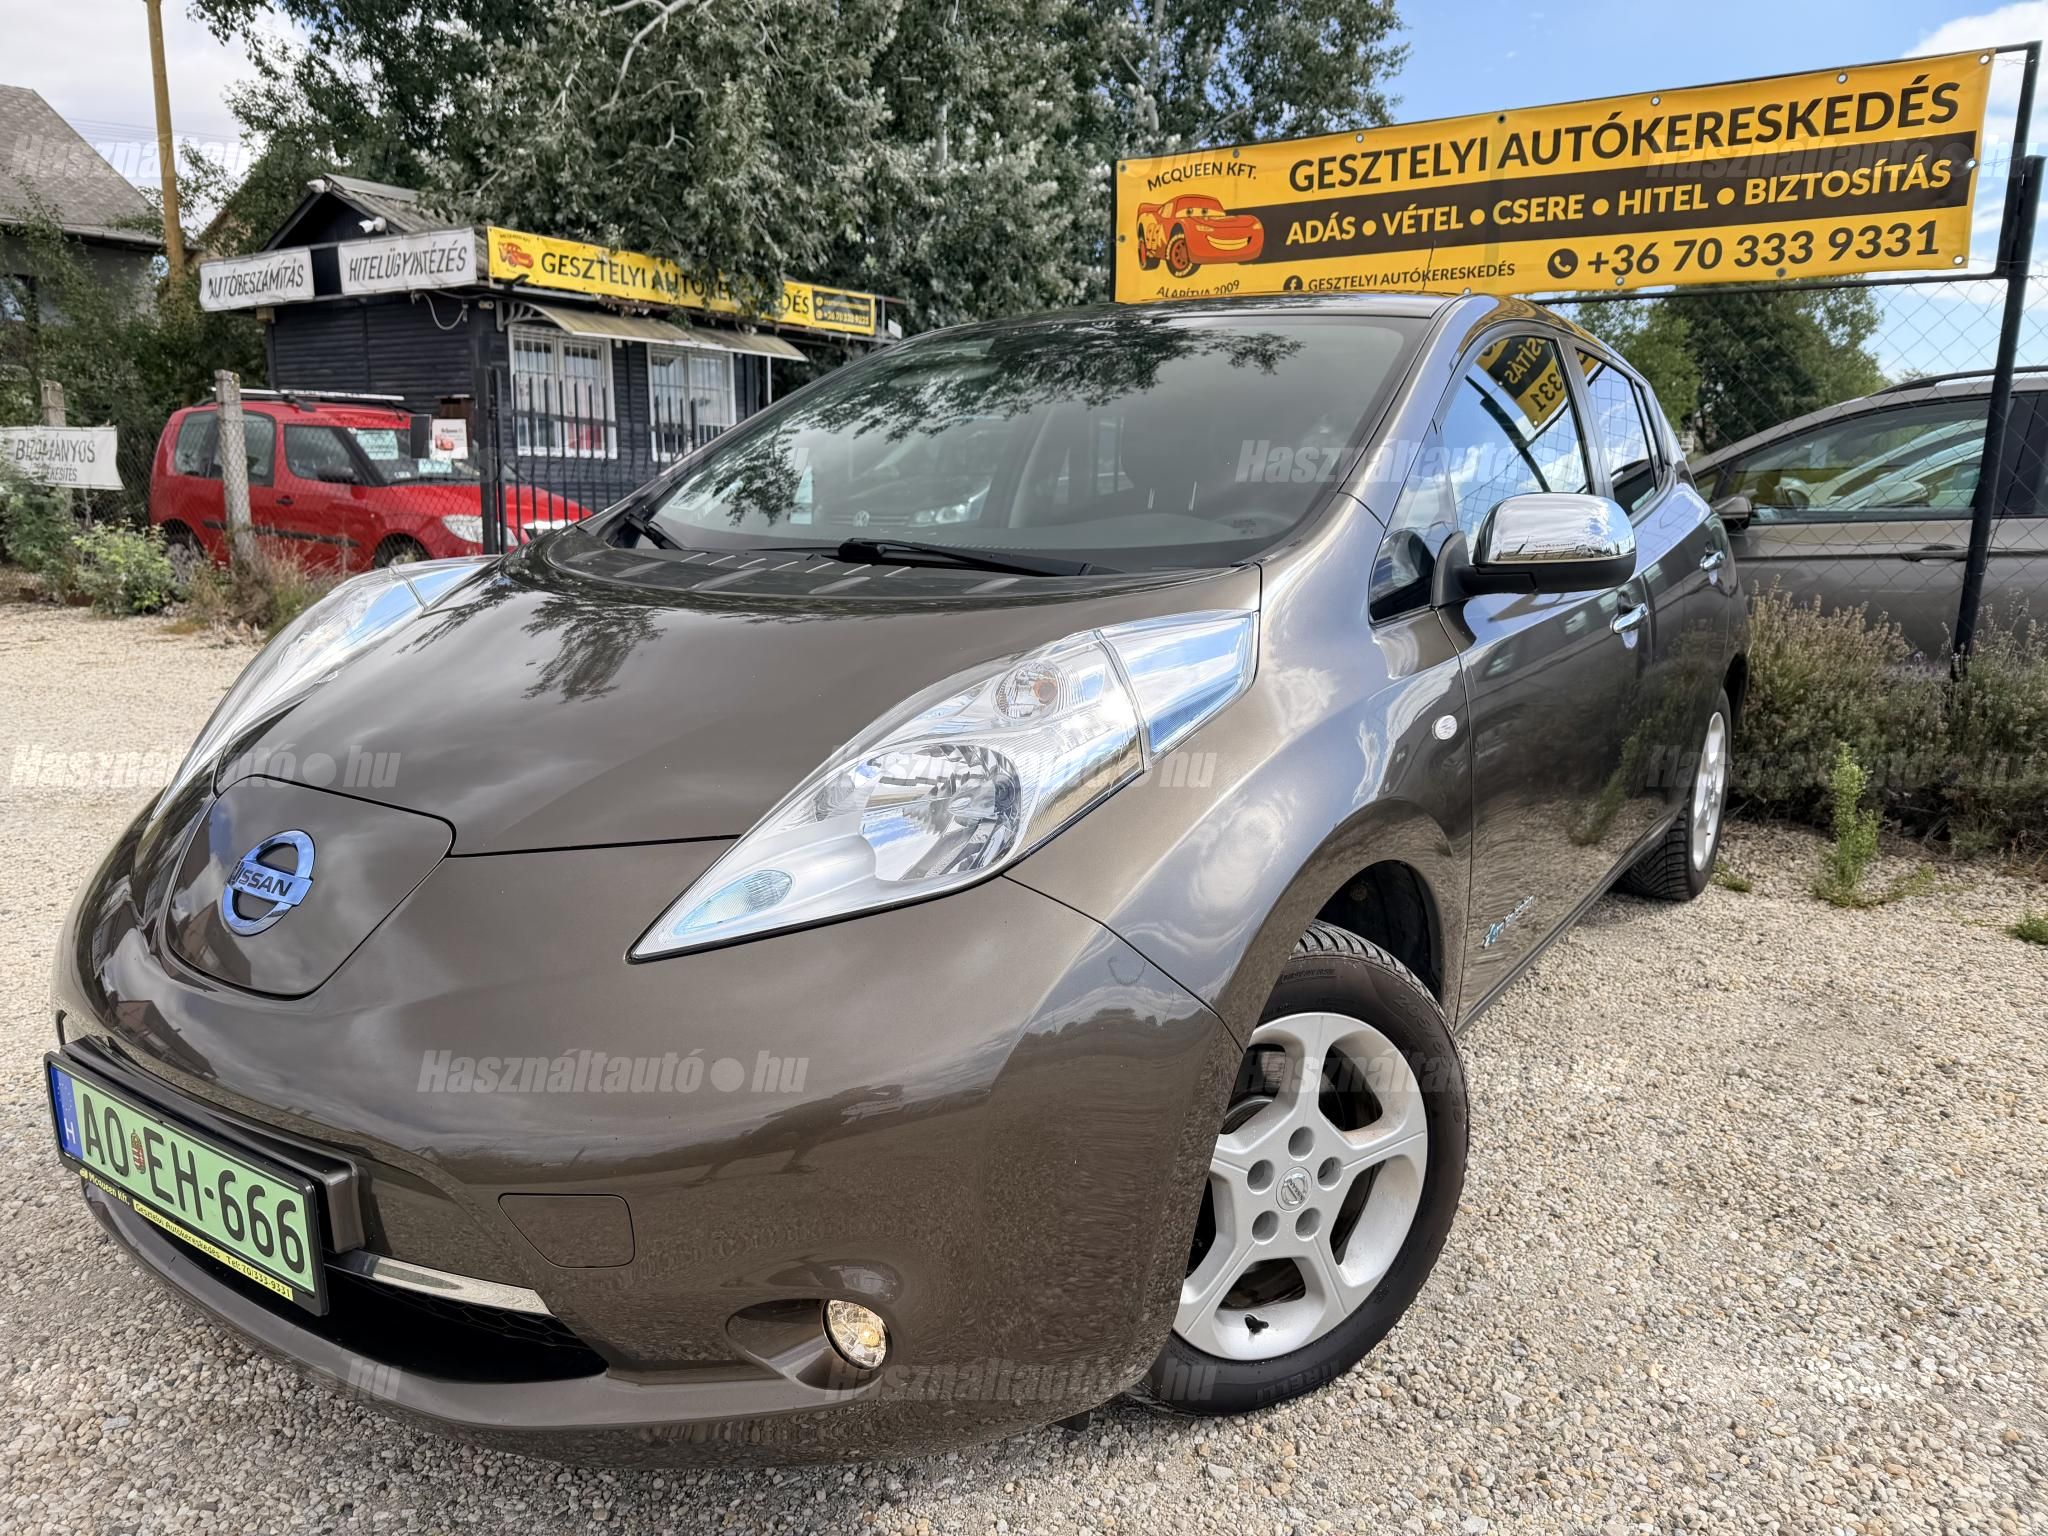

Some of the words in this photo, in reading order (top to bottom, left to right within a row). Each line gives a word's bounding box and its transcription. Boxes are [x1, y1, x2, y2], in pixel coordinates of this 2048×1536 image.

[1289, 136, 1488, 192] GESZTELYI
[1497, 74, 1960, 169] AUTÓKERESKEDÉS
[1147, 161, 1223, 191] MCQUEEN
[1226, 162, 1257, 180] KFT.
[1285, 212, 1356, 246] ADÁS
[1382, 203, 1463, 236] VÉTEL
[1492, 193, 1585, 226] CSERE
[1618, 183, 1709, 216] HITEL
[1744, 154, 1952, 206] BIZTOSÍTÁS
[350, 240, 467, 282] HITELÜGYINTÉZÉS
[1587, 242, 1660, 276] +36
[1673, 237, 1723, 272] 70
[1734, 230, 1814, 268] 333
[1828, 219, 1939, 261] 9331
[208, 258, 304, 299] AUTÓBESZÁMÍTÁS
[541, 252, 646, 288] GESZTELYI
[1214, 279, 1240, 295] 2009
[1308, 273, 1378, 291] GESZTELYI
[1380, 259, 1516, 286] AUTÓKERESKEDÉS
[64, 1118, 77, 1145] H
[83, 1093, 130, 1177] AO
[143, 1127, 305, 1274] EH-666
